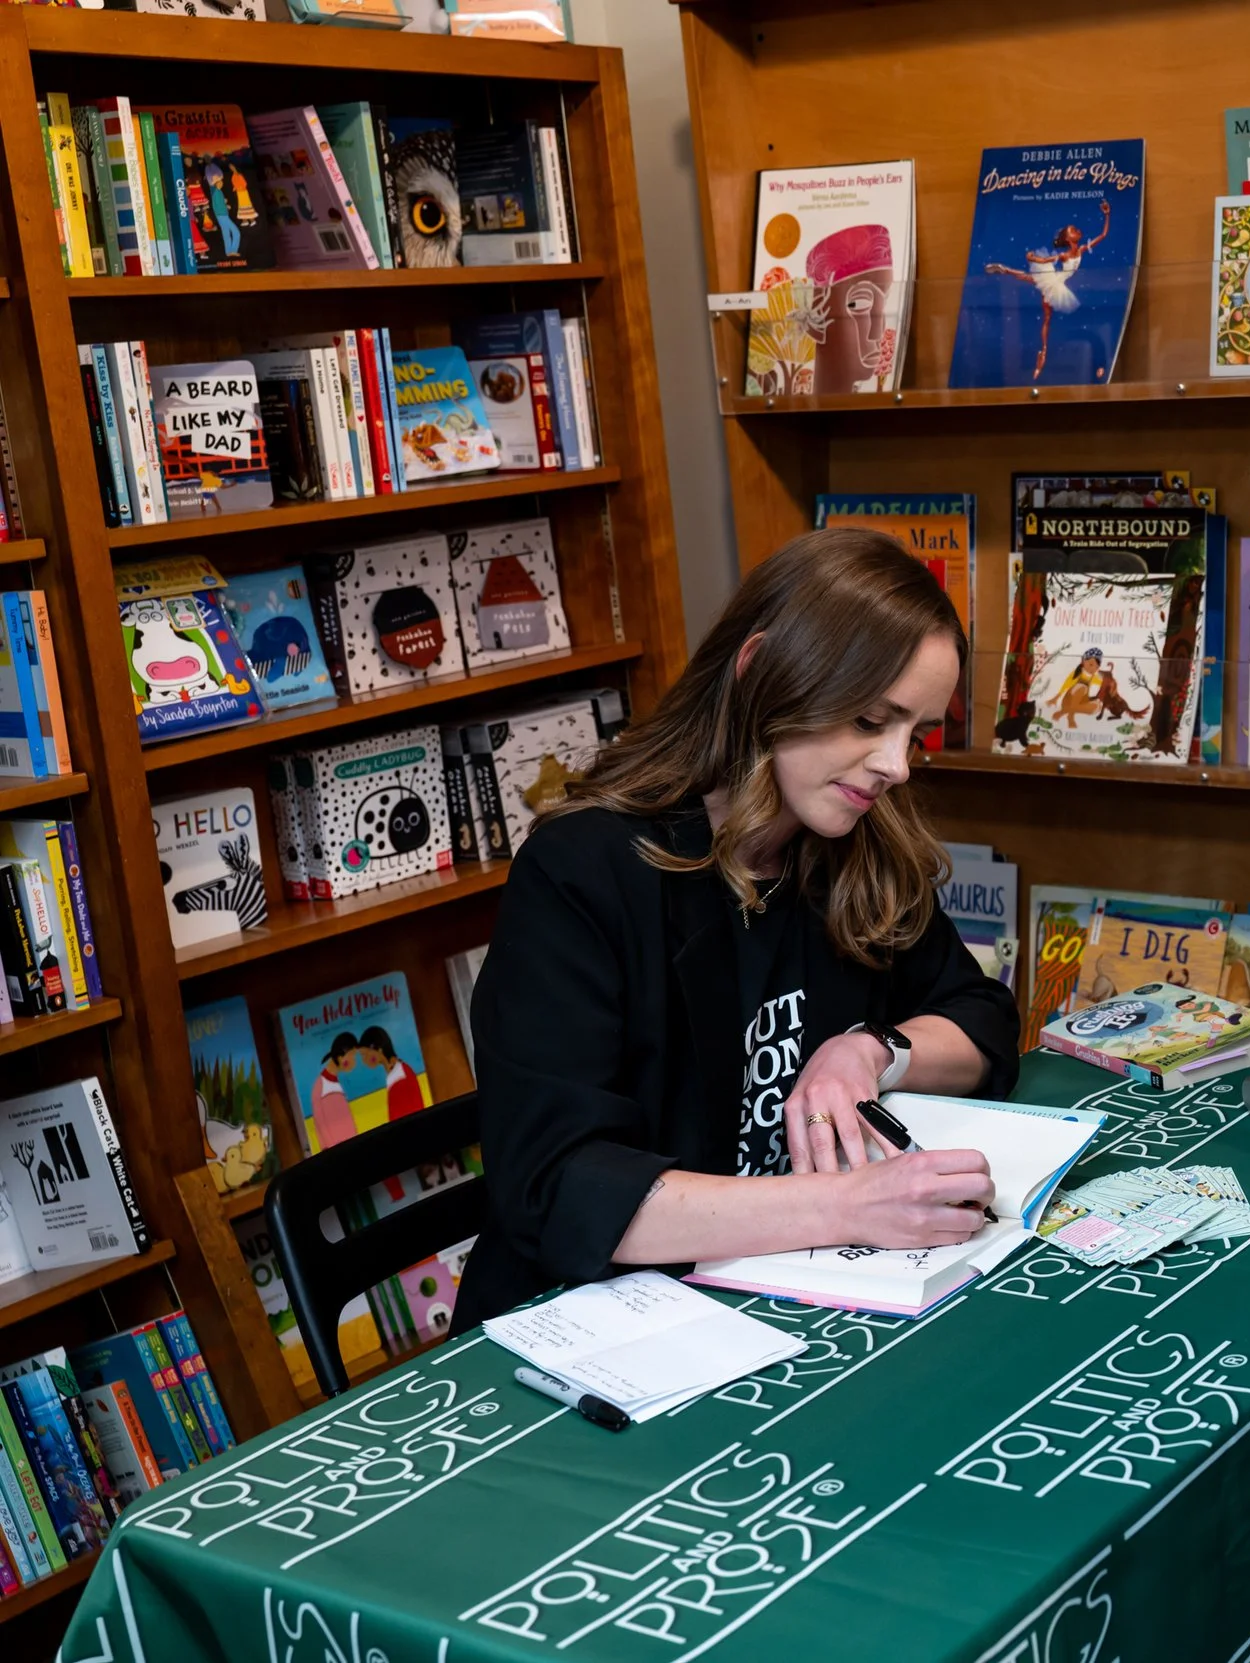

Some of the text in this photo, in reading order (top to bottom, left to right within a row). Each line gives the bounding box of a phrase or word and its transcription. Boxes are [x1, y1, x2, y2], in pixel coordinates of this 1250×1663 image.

[1021, 147, 1103, 163] DEBBIE ALLEN
[768, 182, 784, 194] Why
[828, 178, 846, 188] Buzz
[886, 173, 903, 184] Ears
[981, 159, 1140, 195] Dancing in the Wings
[175, 178, 188, 218] Claude
[96, 355, 115, 428] Kiss by Kiss
[166, 380, 253, 399] A BEARD
[172, 409, 247, 431] LIKE MY
[204, 432, 242, 453] DAD
[909, 527, 960, 550] Mark
[1041, 519, 1192, 538] NORTHBOUND
[1062, 539, 1170, 549] A Train Ride Out of Segregation
[1053, 606, 1156, 629] ONE MILLION TREES
[1104, 630, 1126, 645] STORY
[142, 696, 239, 730] by Sandra Boynton
[336, 749, 425, 777] Cuddly LADYBUG
[174, 803, 252, 839] HELLO
[1119, 927, 1193, 965] I DIG
[292, 983, 400, 1036] You Hold Me Up
[1069, 1001, 1146, 1036] Crushing
[1104, 1012, 1139, 1031] It
[1134, 1110, 1170, 1130] AND
[954, 1328, 1198, 1492] POLITICS
[1111, 1397, 1163, 1436] AND
[135, 1375, 459, 1540] POLITICS
[323, 1445, 387, 1484] AND
[477, 1447, 791, 1642] POLITICS
[671, 1529, 734, 1573] AND
